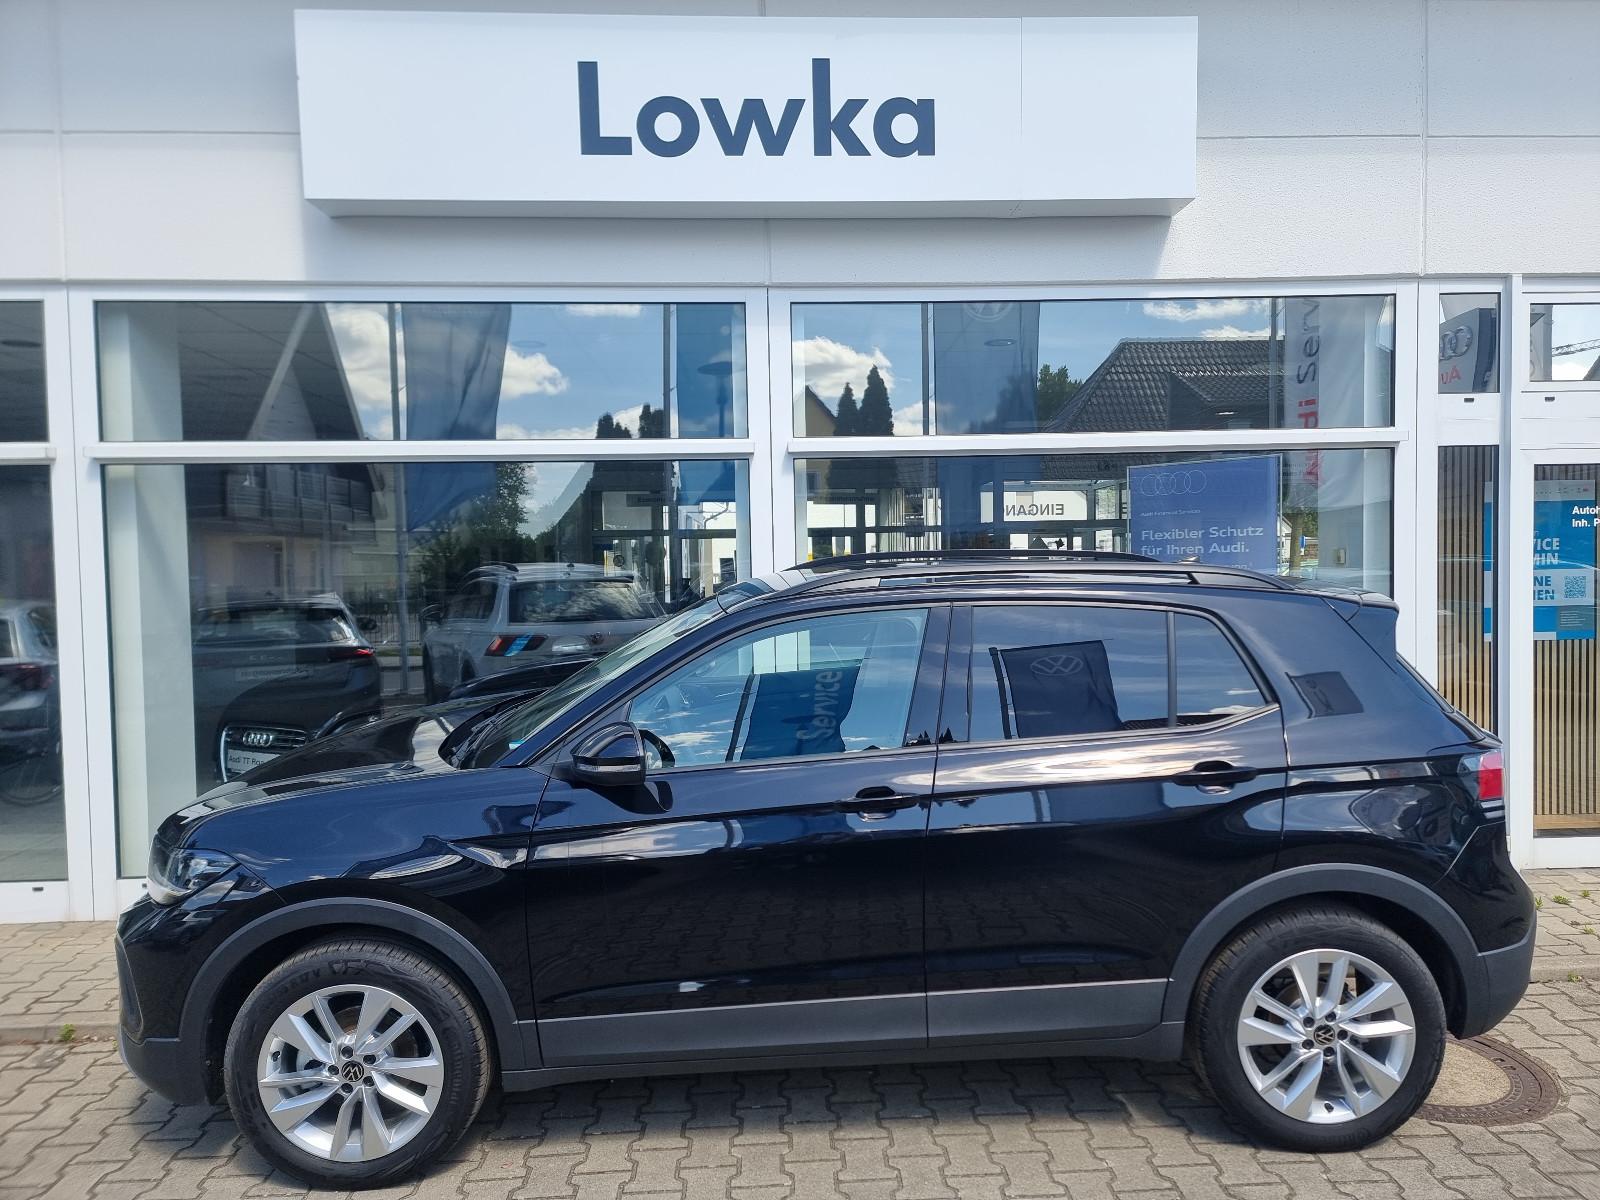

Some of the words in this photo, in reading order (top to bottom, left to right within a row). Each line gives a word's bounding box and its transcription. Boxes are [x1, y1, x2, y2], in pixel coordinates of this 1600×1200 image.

[577, 57, 935, 158] Lowka
[1572, 518, 1590, 528] Inh.
[1141, 528, 1204, 541] Flexibler
[1209, 525, 1264, 538] Schutz
[1141, 545, 1162, 556] für
[1167, 544, 1204, 555] Ihren
[1209, 542, 1250, 553] Audi.
[796, 671, 842, 740] Service
